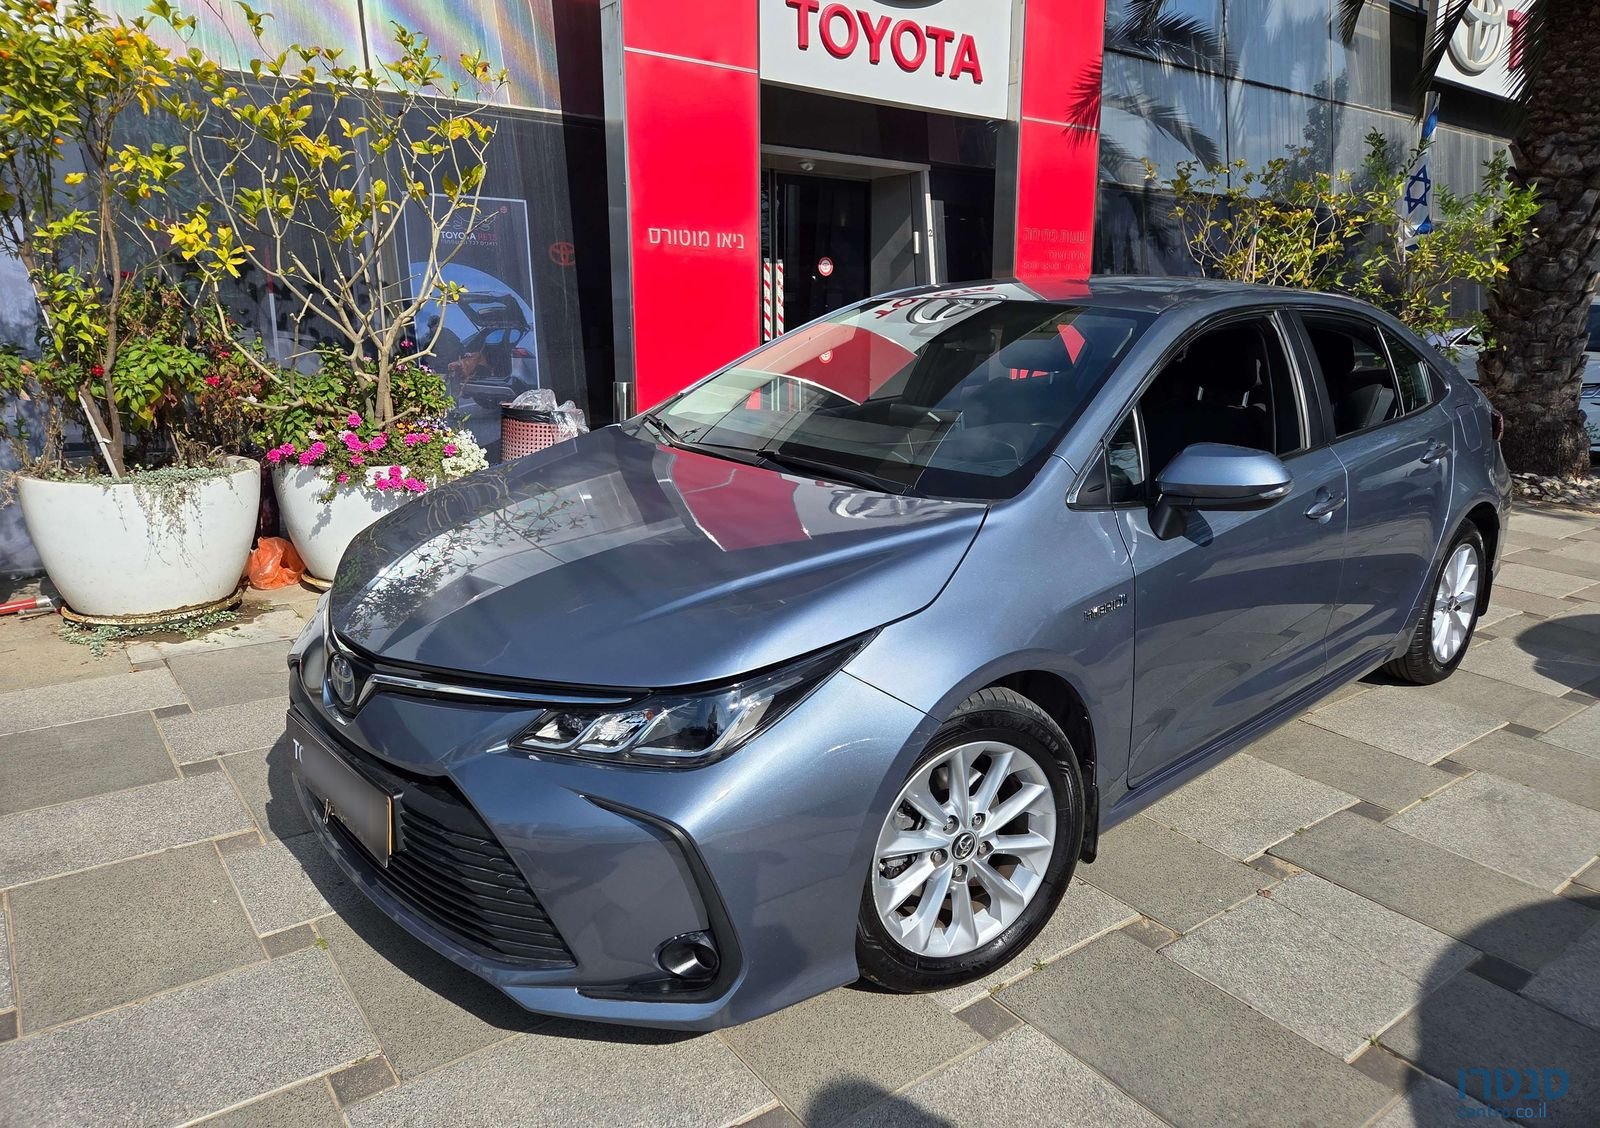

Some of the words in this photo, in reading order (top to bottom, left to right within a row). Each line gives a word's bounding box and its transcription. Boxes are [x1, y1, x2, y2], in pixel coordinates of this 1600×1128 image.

[786, 0, 983, 84] TOYOTA
[441, 231, 476, 240] TOYOA
[716, 231, 745, 250] ניאו
